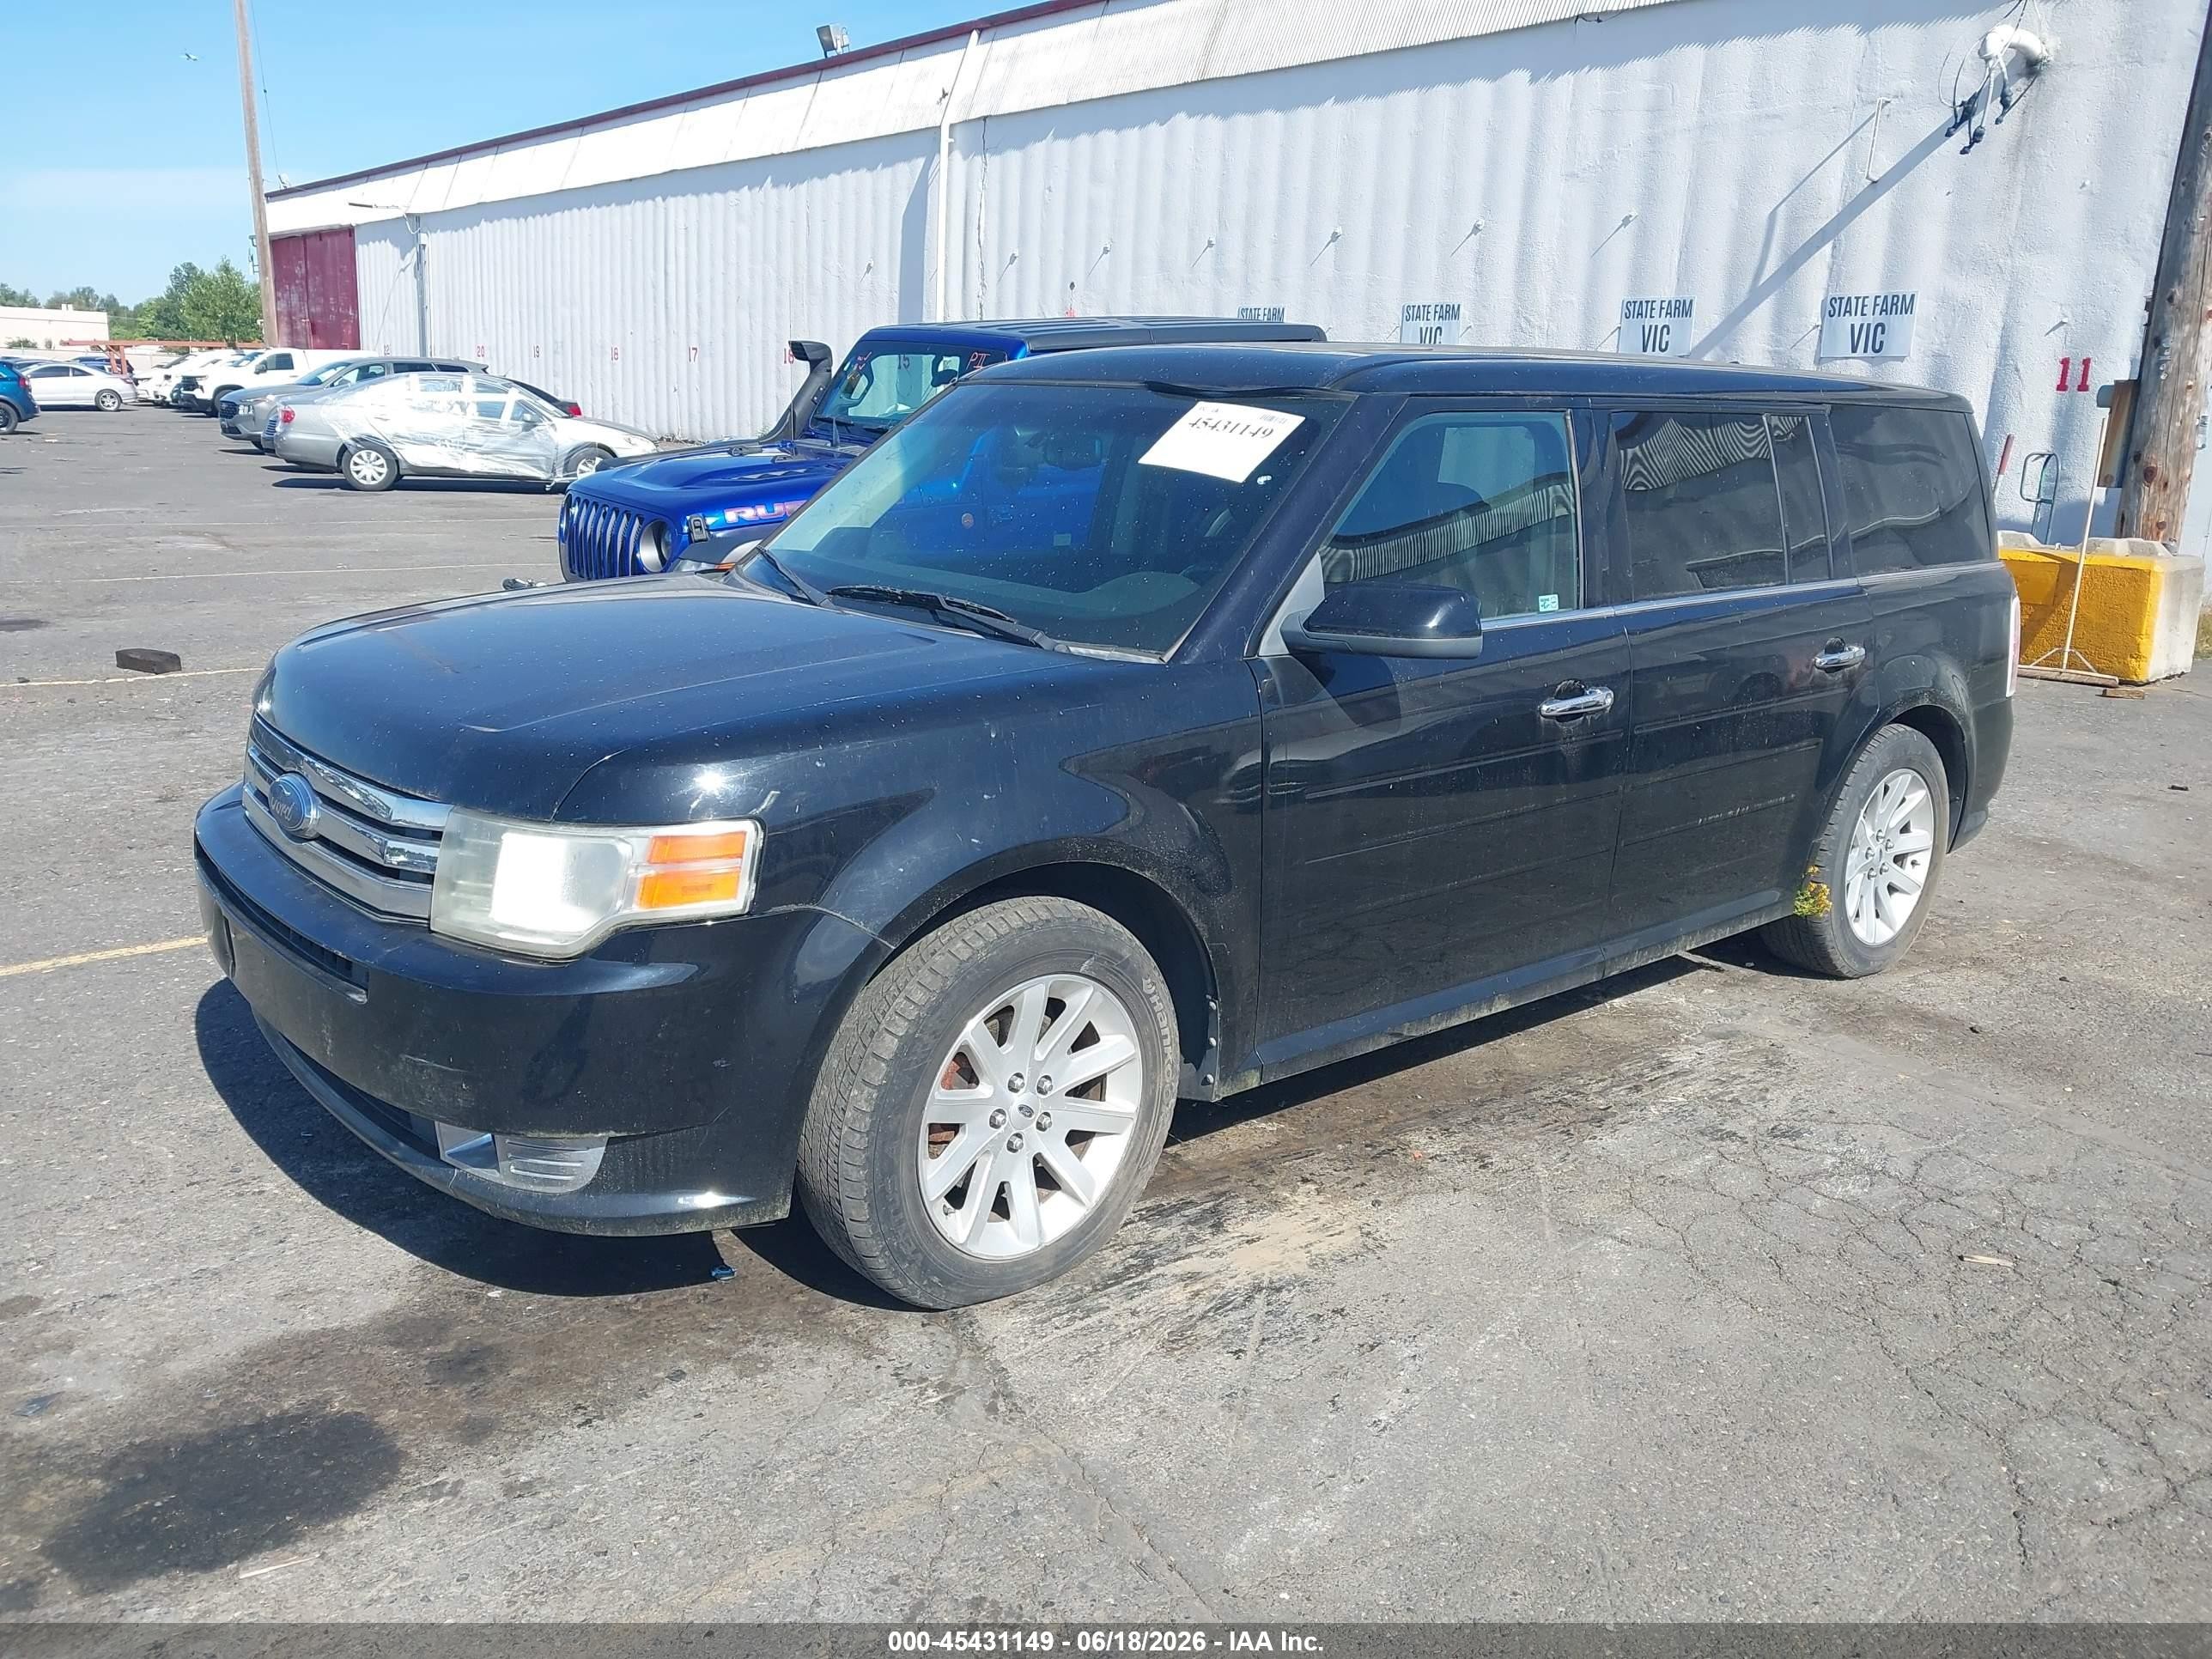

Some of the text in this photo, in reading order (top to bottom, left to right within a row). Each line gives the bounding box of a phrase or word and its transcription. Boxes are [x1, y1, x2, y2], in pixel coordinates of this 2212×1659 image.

[1240, 307, 1285, 322] STATE FARM
[1405, 304, 1461, 322] STATE FARM
[1625, 299, 1693, 319] STATE FARM
[1827, 294, 1915, 318] STATE FARM
[1419, 325, 1443, 344] VIC
[1641, 325, 1670, 353] VIC
[1850, 322, 1886, 354] VIC
[477, 346, 485, 357] 20
[533, 346, 540, 358] 19
[611, 347, 619, 362] 18
[688, 347, 698, 362] 17
[2056, 357, 2092, 392] 11
[1188, 417, 1274, 439] 45431149
